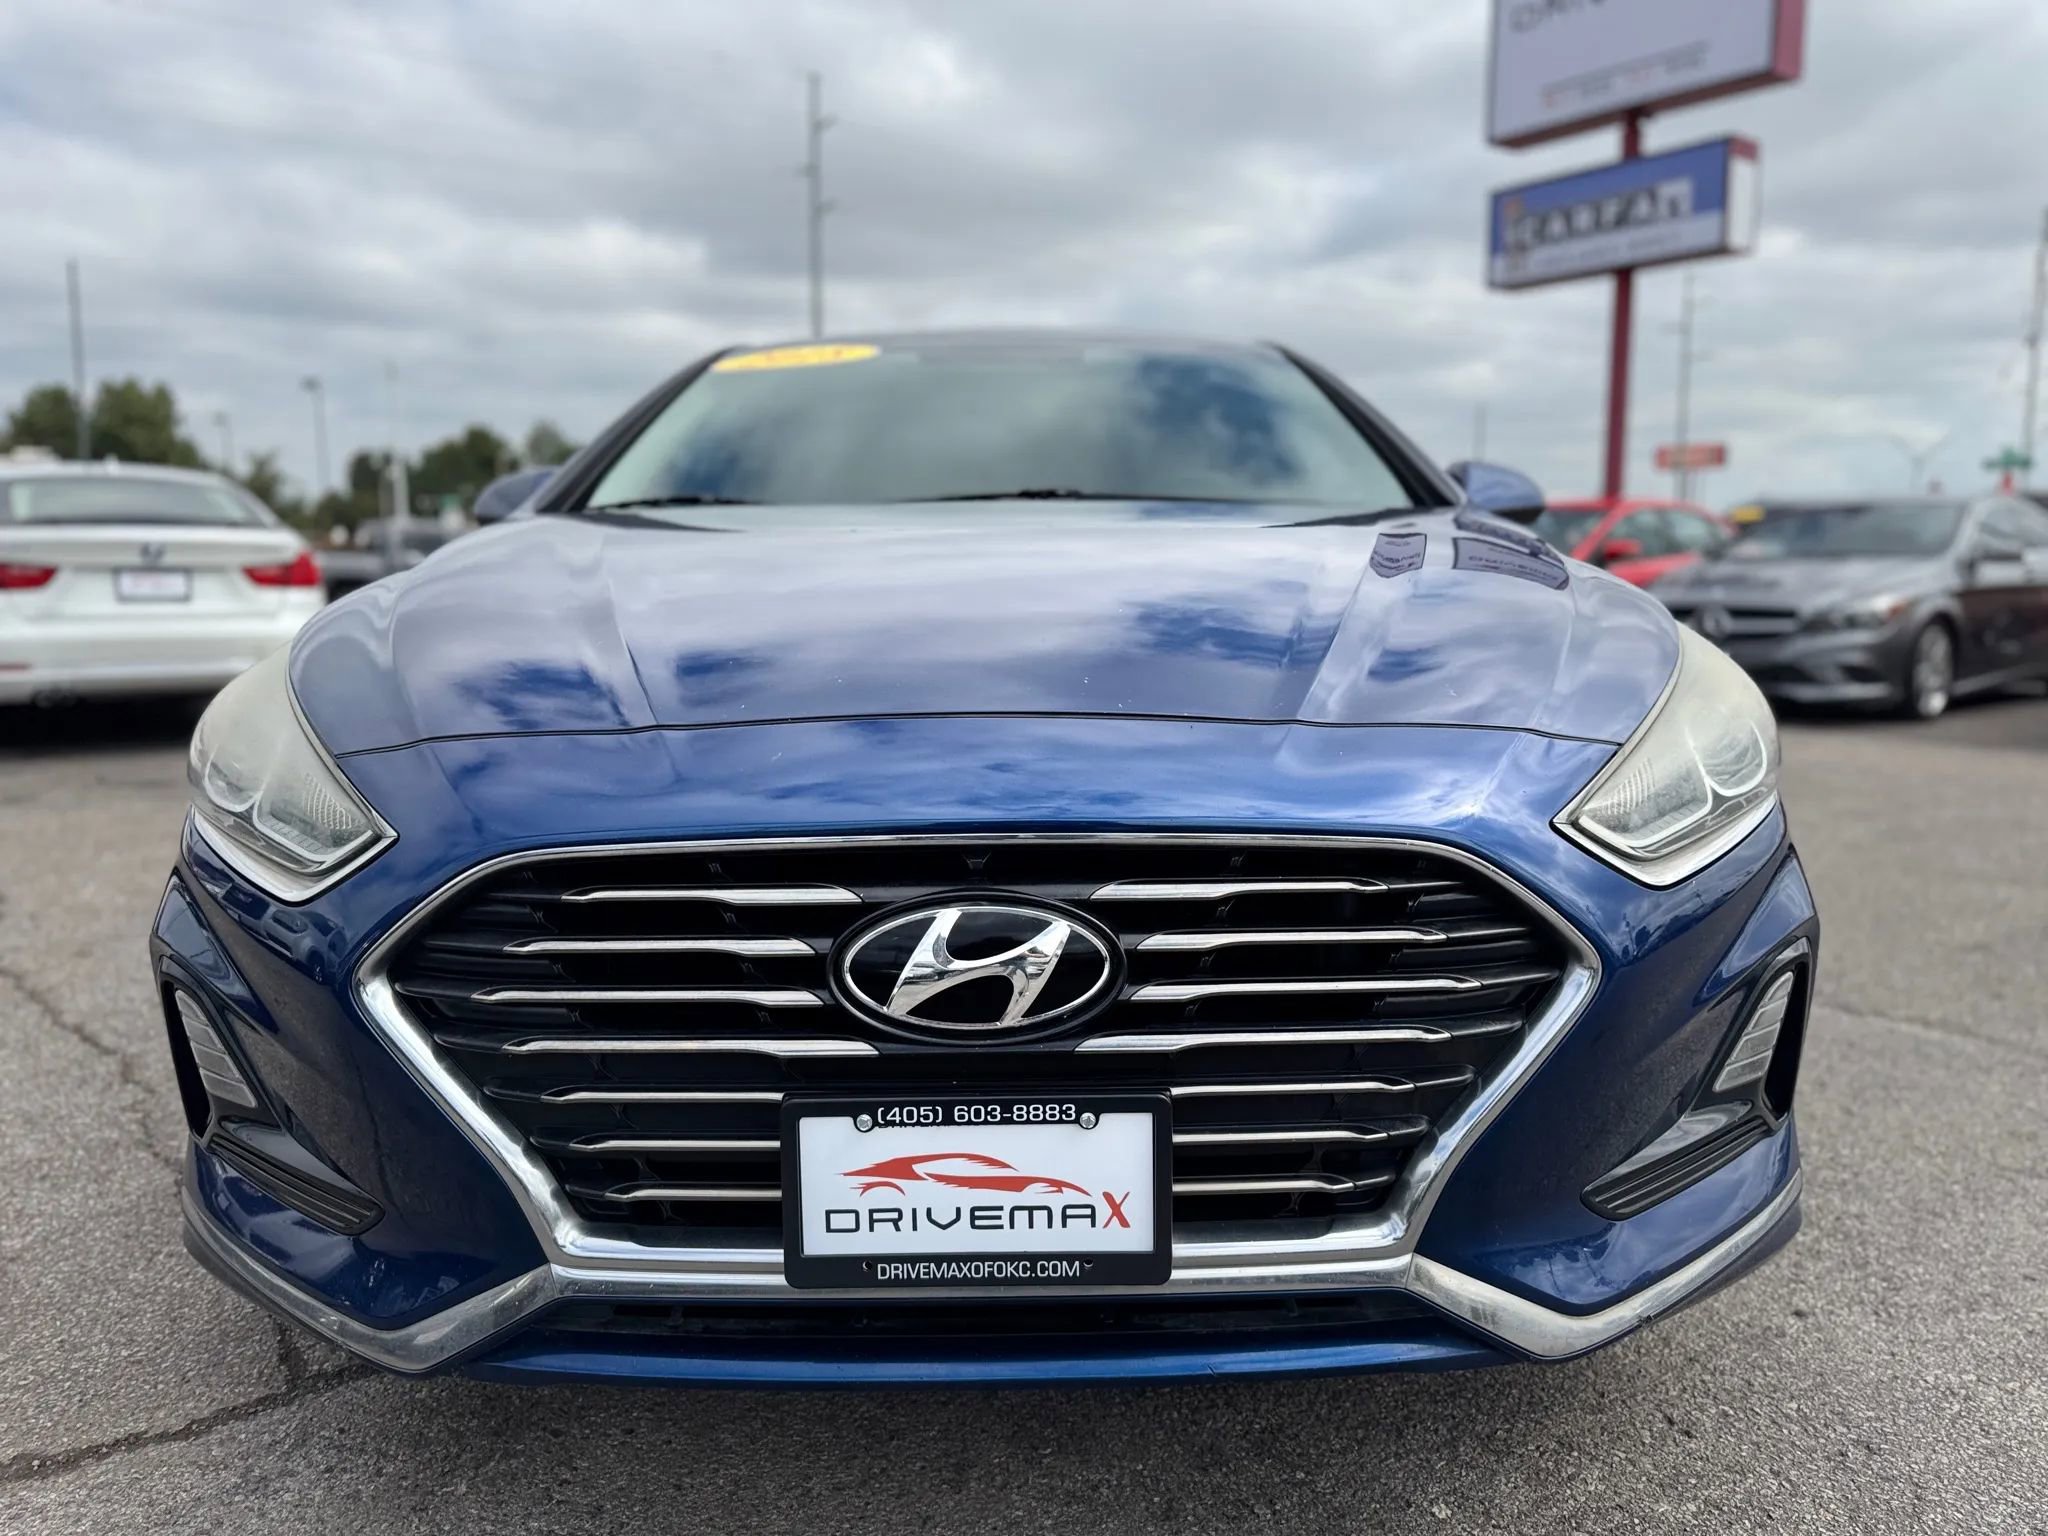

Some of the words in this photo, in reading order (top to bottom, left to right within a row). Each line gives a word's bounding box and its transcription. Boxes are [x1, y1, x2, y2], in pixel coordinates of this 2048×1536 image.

[877, 1106, 943, 1124] (405)
[953, 1103, 1076, 1123] 603-8883
[825, 1191, 1131, 1234] DRIVEMAX
[877, 1260, 1080, 1280] DRIVEMAXOFOKC.COM
